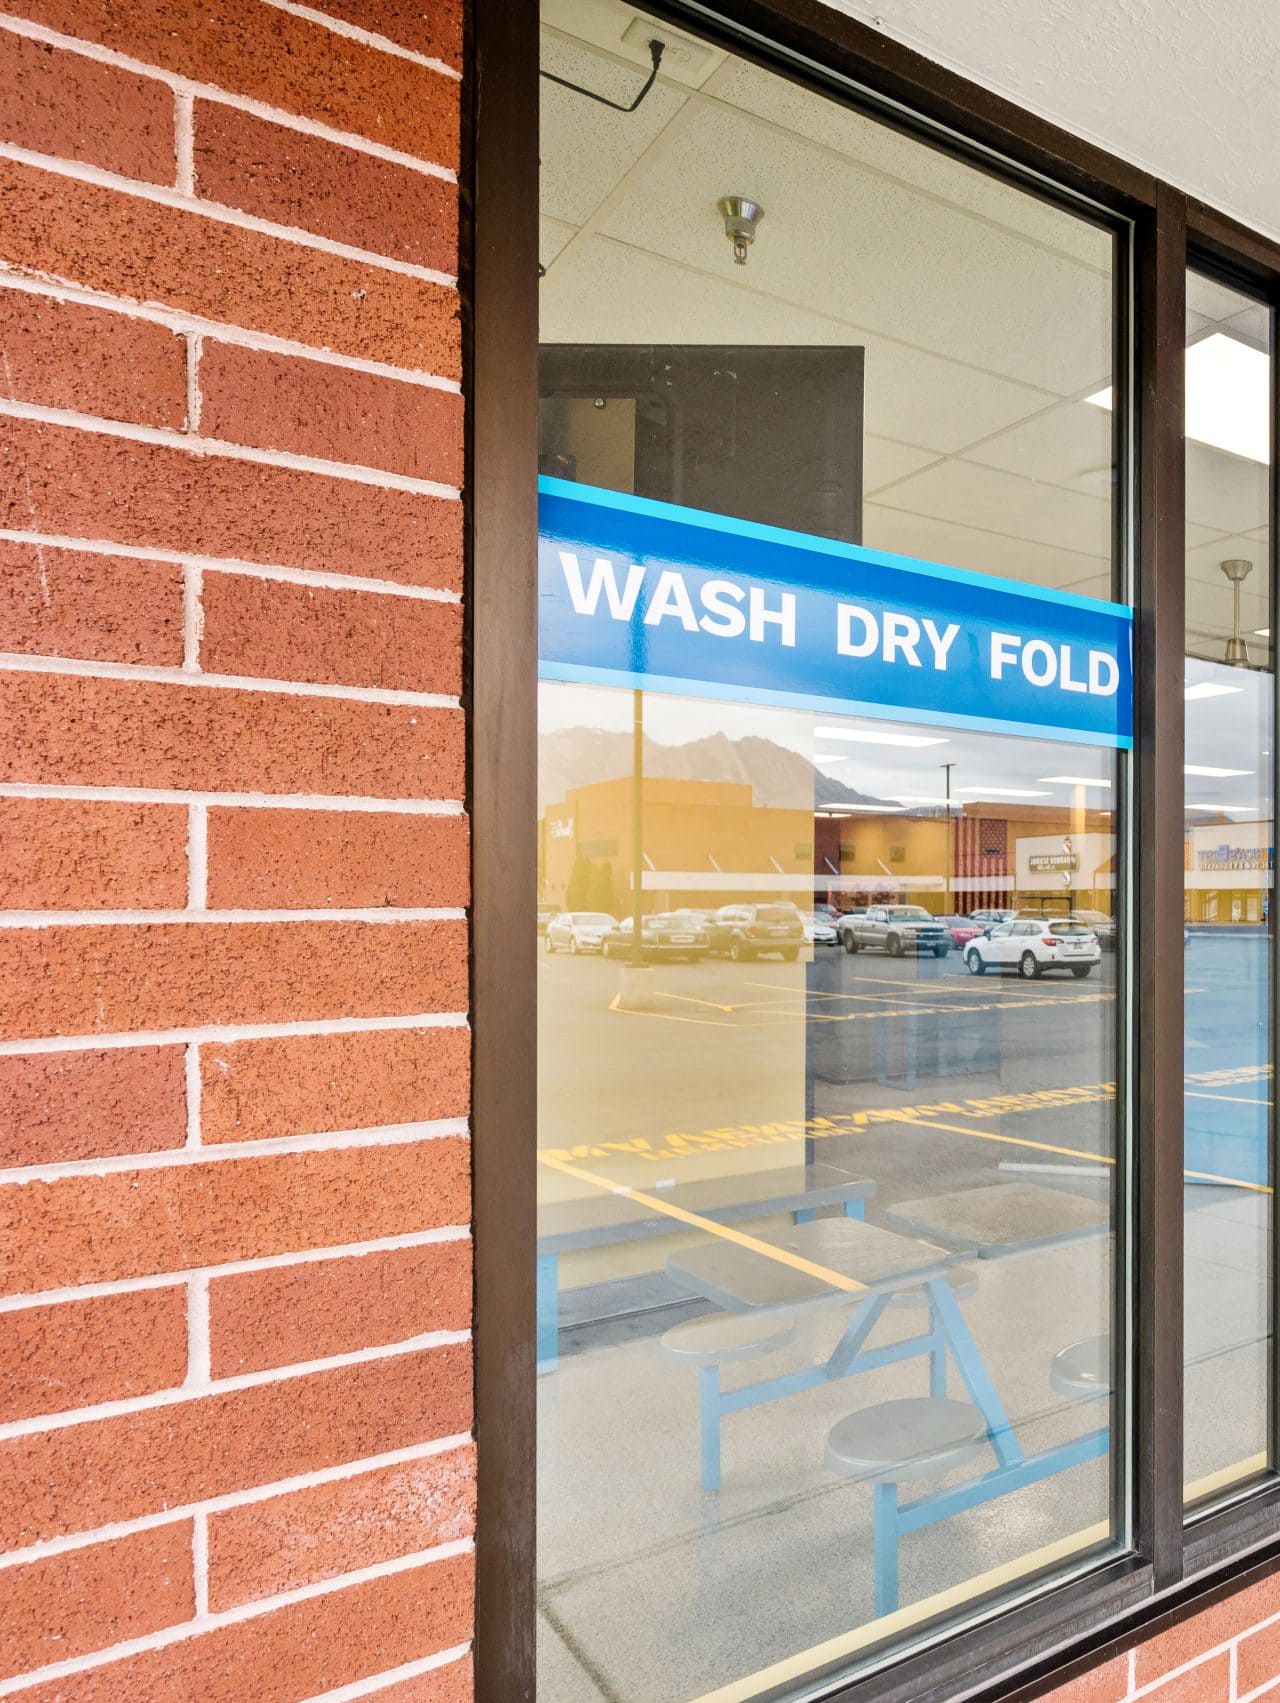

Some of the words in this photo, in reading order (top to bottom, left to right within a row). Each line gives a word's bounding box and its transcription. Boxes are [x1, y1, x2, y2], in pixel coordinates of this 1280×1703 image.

[558, 551, 796, 647] WASH
[837, 602, 960, 671] DRY
[990, 631, 1120, 696] FOLD
